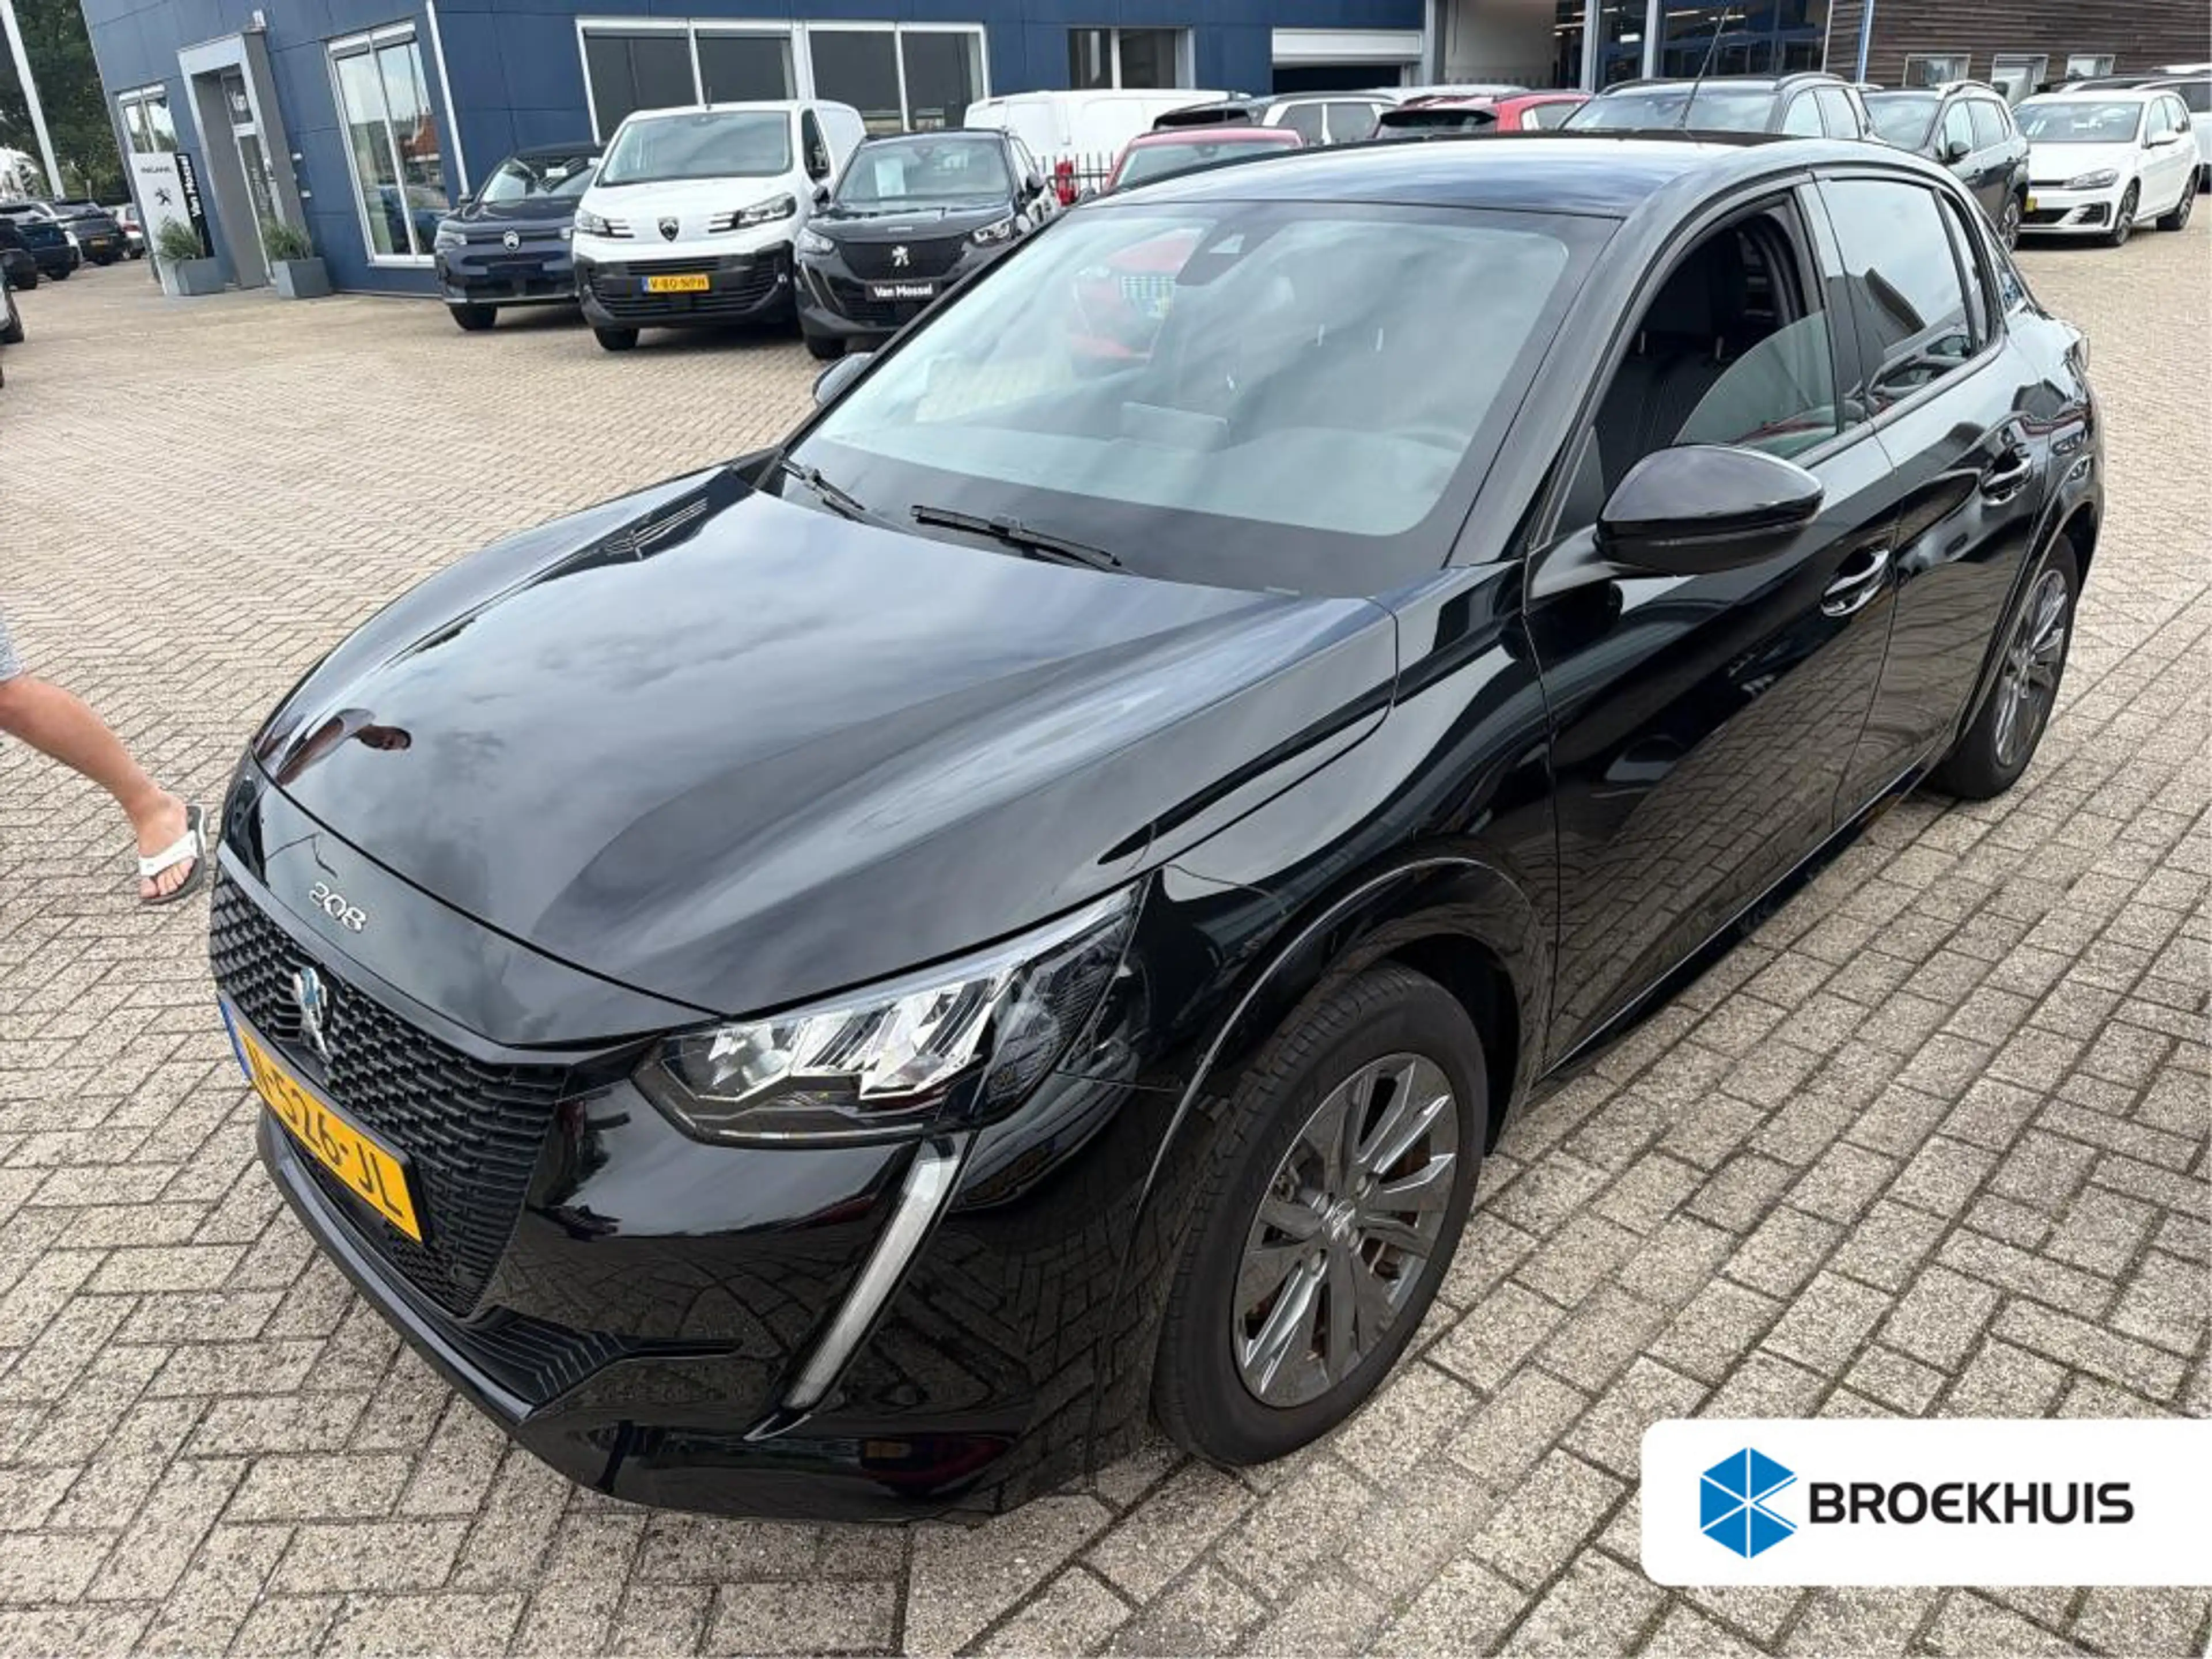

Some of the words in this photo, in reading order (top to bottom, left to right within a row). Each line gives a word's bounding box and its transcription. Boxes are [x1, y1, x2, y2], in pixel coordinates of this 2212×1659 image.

[874, 286, 894, 298] Van
[895, 282, 932, 297] Mossel
[309, 881, 366, 931] 208
